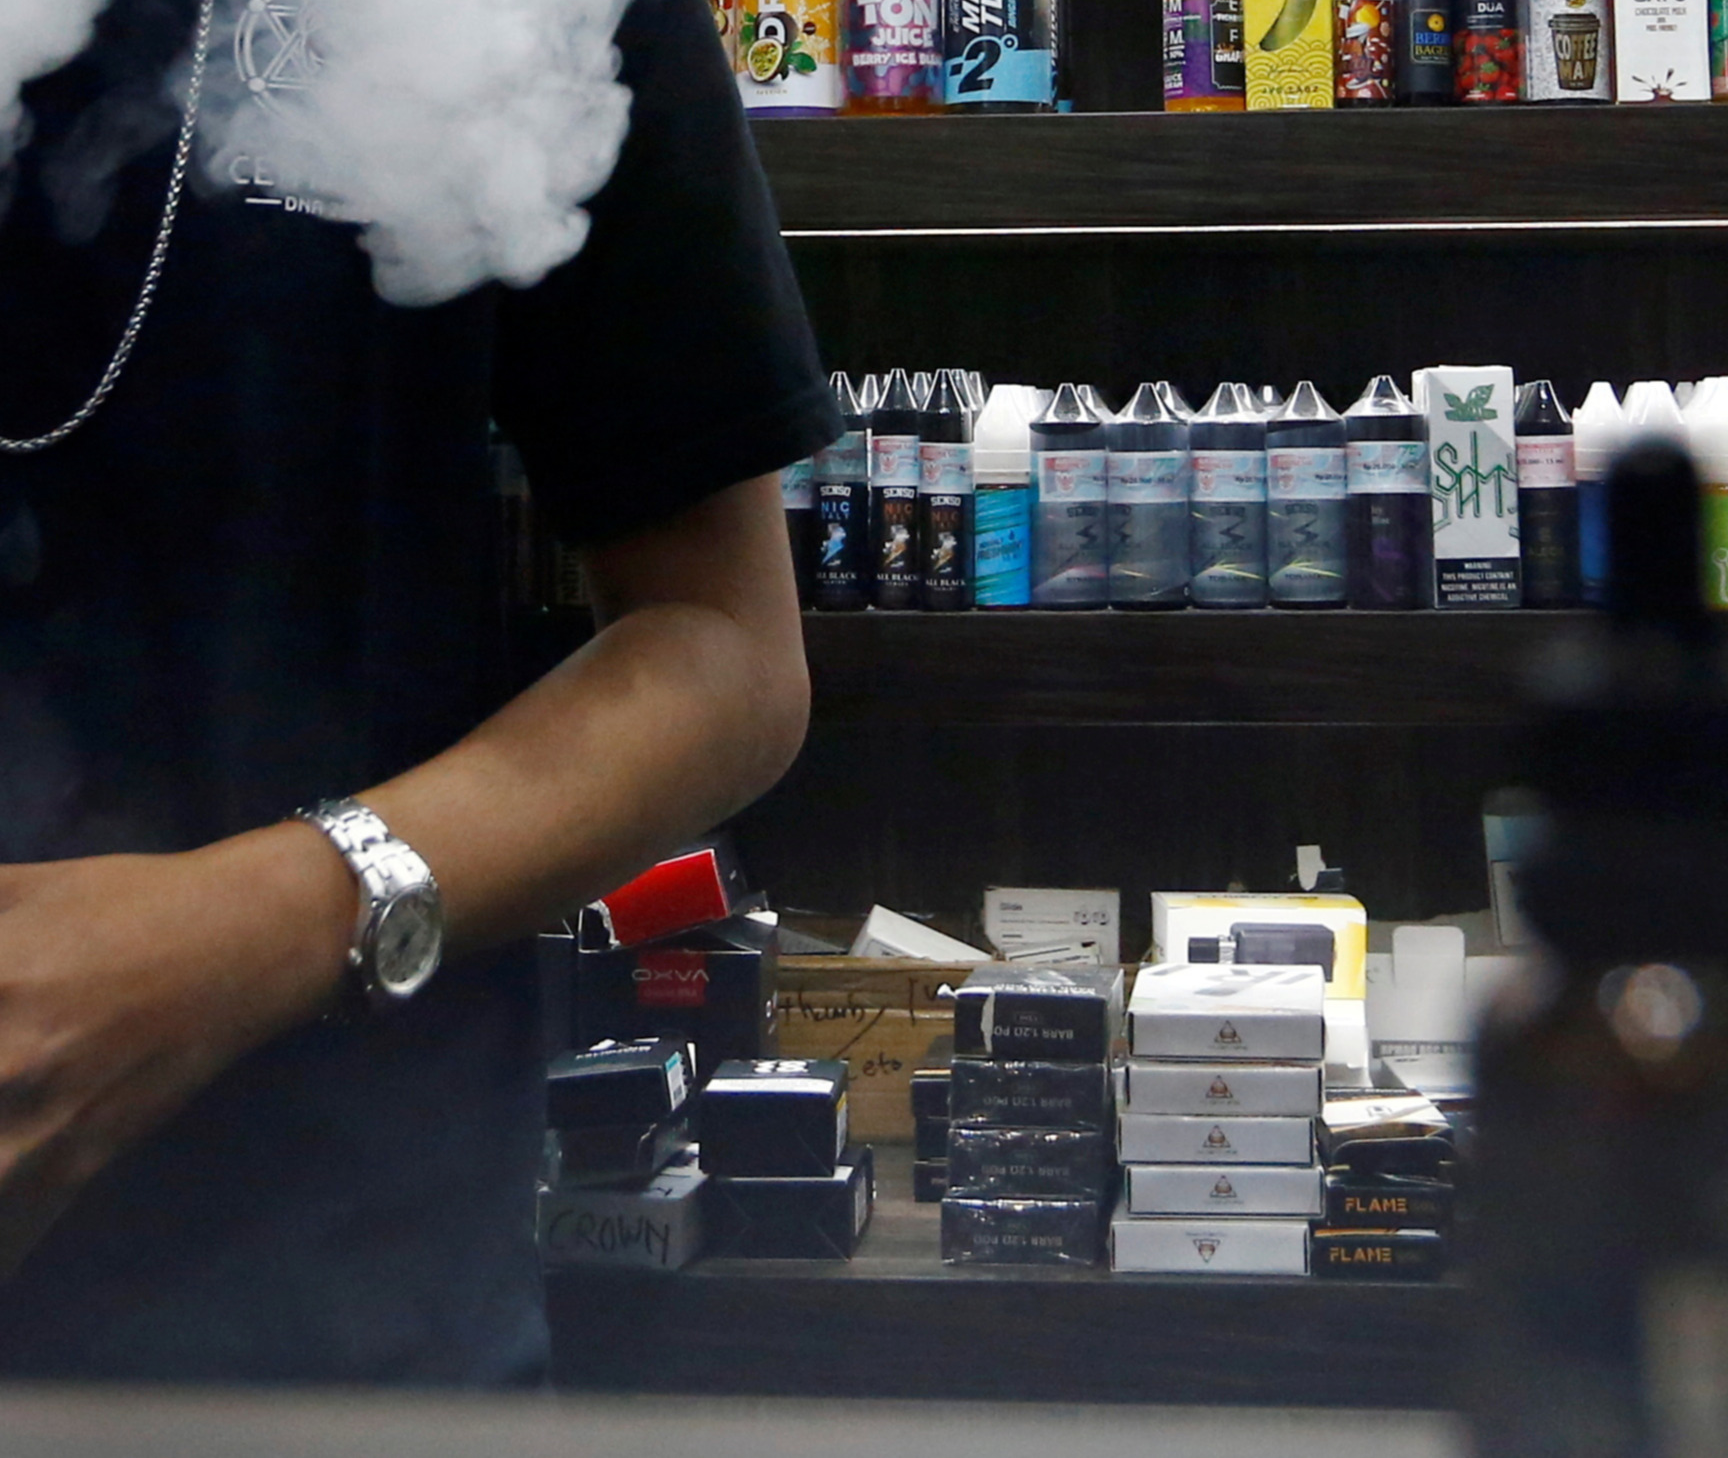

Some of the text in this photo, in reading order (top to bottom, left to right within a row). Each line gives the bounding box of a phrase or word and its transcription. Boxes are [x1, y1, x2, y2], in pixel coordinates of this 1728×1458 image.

[871, 27, 934, 48] JUICE
[1555, 34, 1597, 61] COFFEE
[852, 51, 917, 66] BERRY ICE
[1560, 60, 1593, 83] MAN
[821, 502, 850, 514] NIC
[631, 968, 710, 983] OXVA
[1344, 1196, 1408, 1214] FLAME
[1328, 1246, 1393, 1263] FLAME
